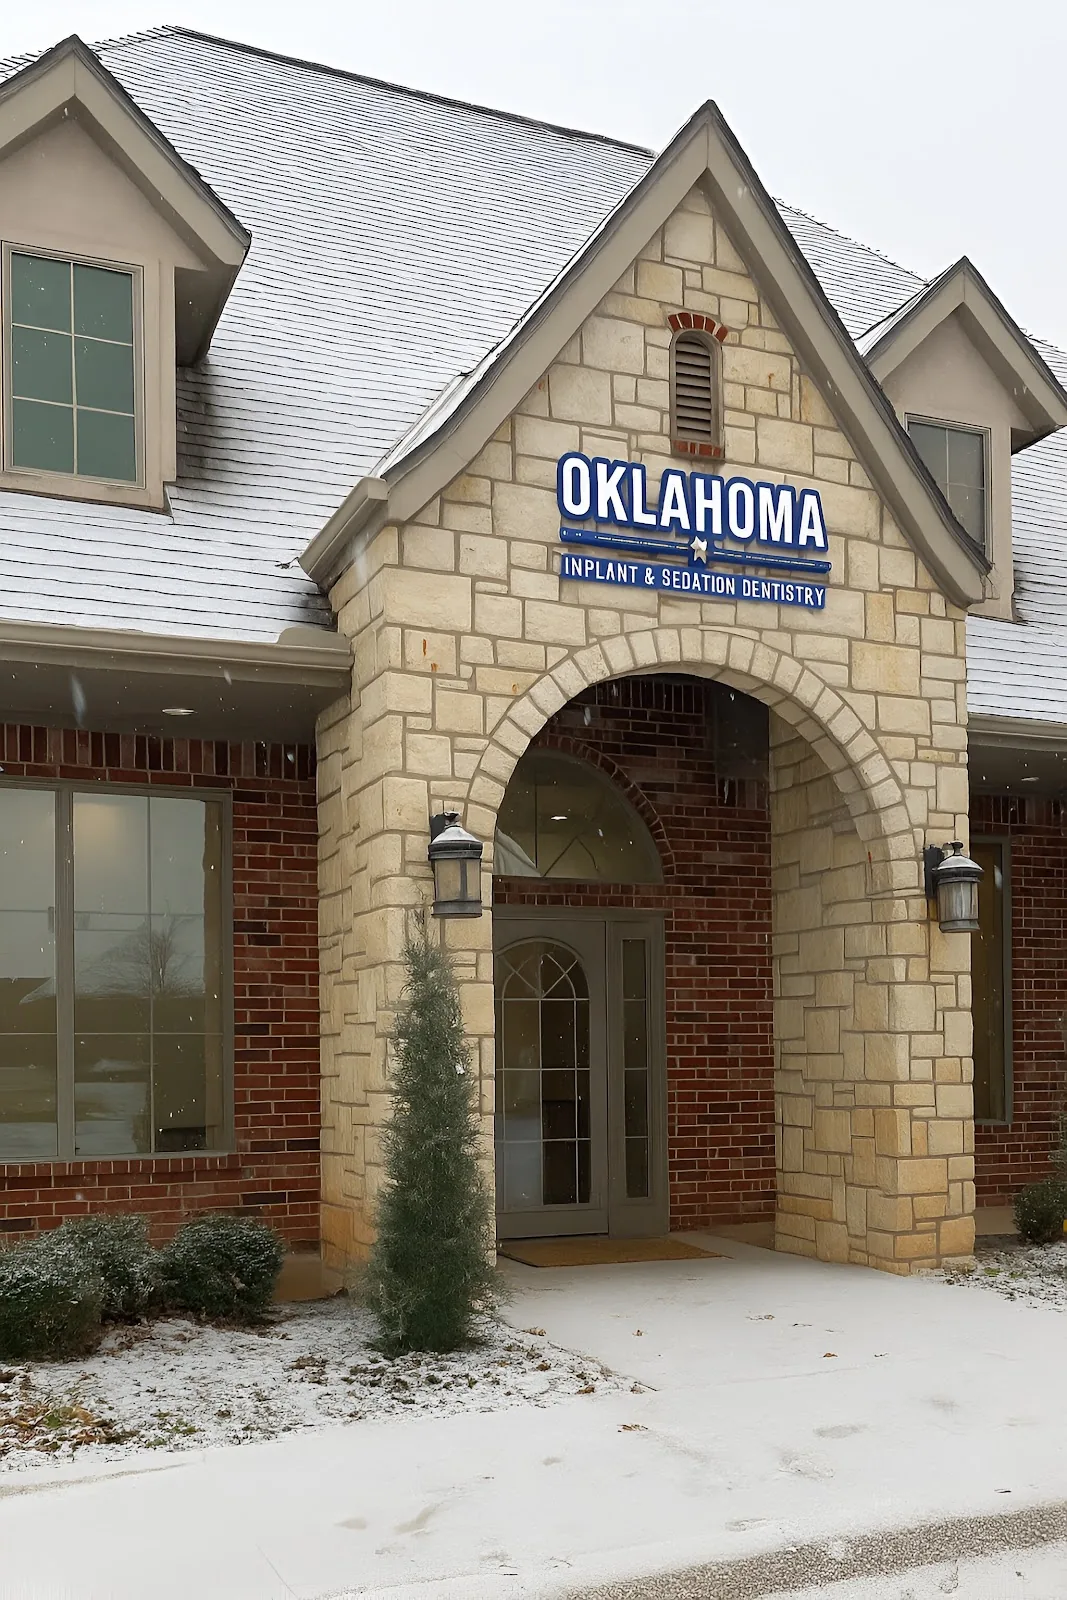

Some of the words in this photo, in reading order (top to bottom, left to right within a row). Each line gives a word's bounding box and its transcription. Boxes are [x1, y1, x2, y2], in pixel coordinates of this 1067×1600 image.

[561, 456, 826, 549] OKLAHOMA
[565, 557, 638, 584] INPLANT
[644, 567, 655, 585] &
[662, 569, 735, 595] SEDATION
[742, 579, 824, 606] DENTISTRY
